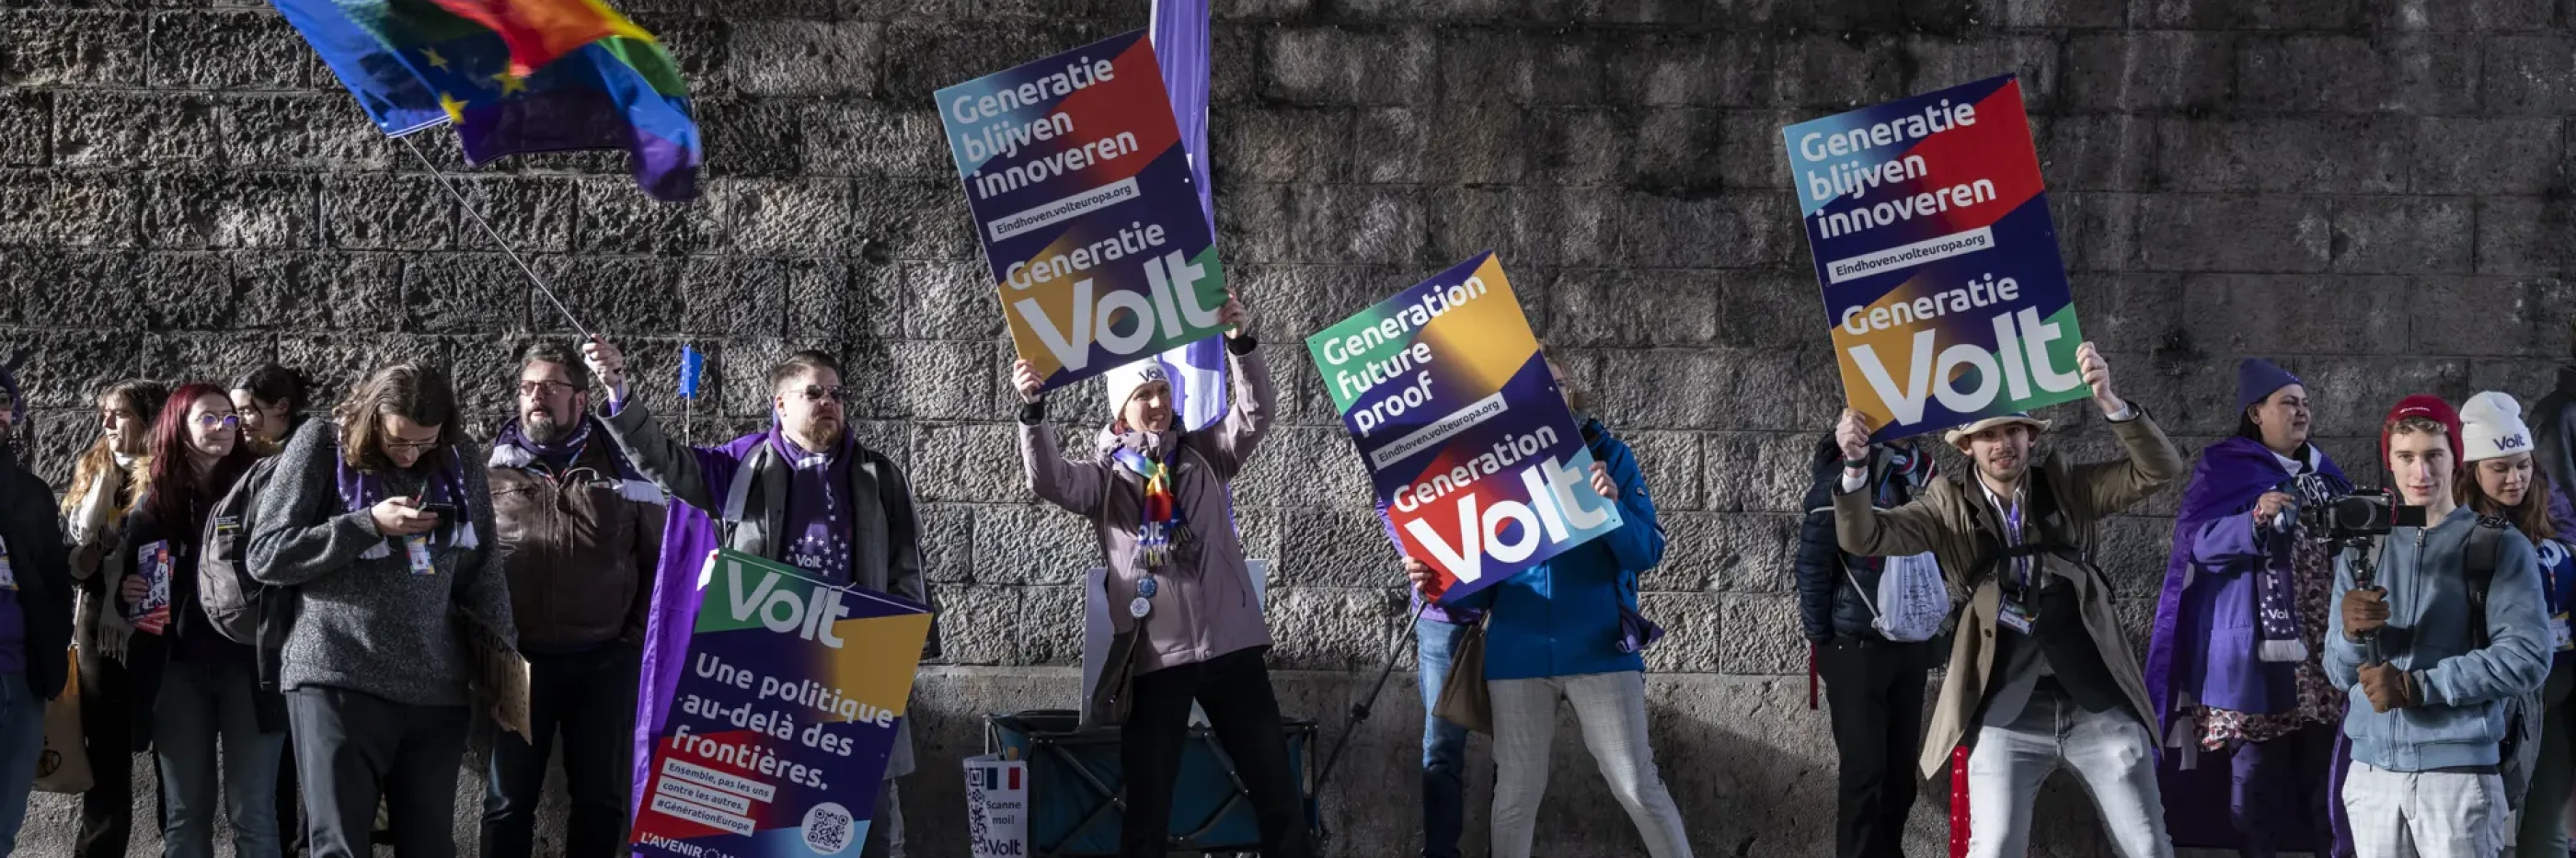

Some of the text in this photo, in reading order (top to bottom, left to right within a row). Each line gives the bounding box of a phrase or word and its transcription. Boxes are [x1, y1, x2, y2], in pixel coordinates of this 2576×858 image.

[952, 56, 1114, 125] Generatie
[961, 110, 1074, 163] blijven
[1800, 98, 1976, 163] Generatie
[973, 131, 1138, 200] innoveren
[1807, 154, 1927, 201] blijven
[996, 183, 1132, 235] Eindhoven.volteuropa.org
[1816, 178, 1995, 239] innoveren
[1006, 221, 1166, 291] Generatie
[1835, 233, 1985, 277] Eindhoven.volteuropa.org
[1014, 248, 1220, 372] Volt
[1323, 275, 1487, 366] Generation
[1841, 272, 2019, 336] Generatie
[1336, 341, 1433, 401] future
[1847, 305, 2083, 427] Volt
[1352, 372, 1434, 439] proof
[1378, 399, 1500, 463] Eindhoven.volteuropa.org
[1393, 424, 1558, 514] Generation
[2492, 433, 2525, 452] Volt
[1137, 521, 1165, 542] olt
[1403, 456, 1609, 585] Volt
[795, 554, 822, 567] Volt
[727, 559, 850, 649] Volt
[2267, 608, 2290, 621] Vol
[695, 652, 894, 729] Une politique
[682, 692, 855, 758] au-delà des
[667, 762, 770, 798] Ensemble, pas les uns
[671, 724, 828, 791] frontières.
[656, 798, 751, 833] #GénérationEurope
[662, 782, 744, 812] contre les autres.
[986, 800, 1021, 809] Scanne
[639, 831, 703, 858] L'AVENIR
[988, 839, 1022, 856] Volt
